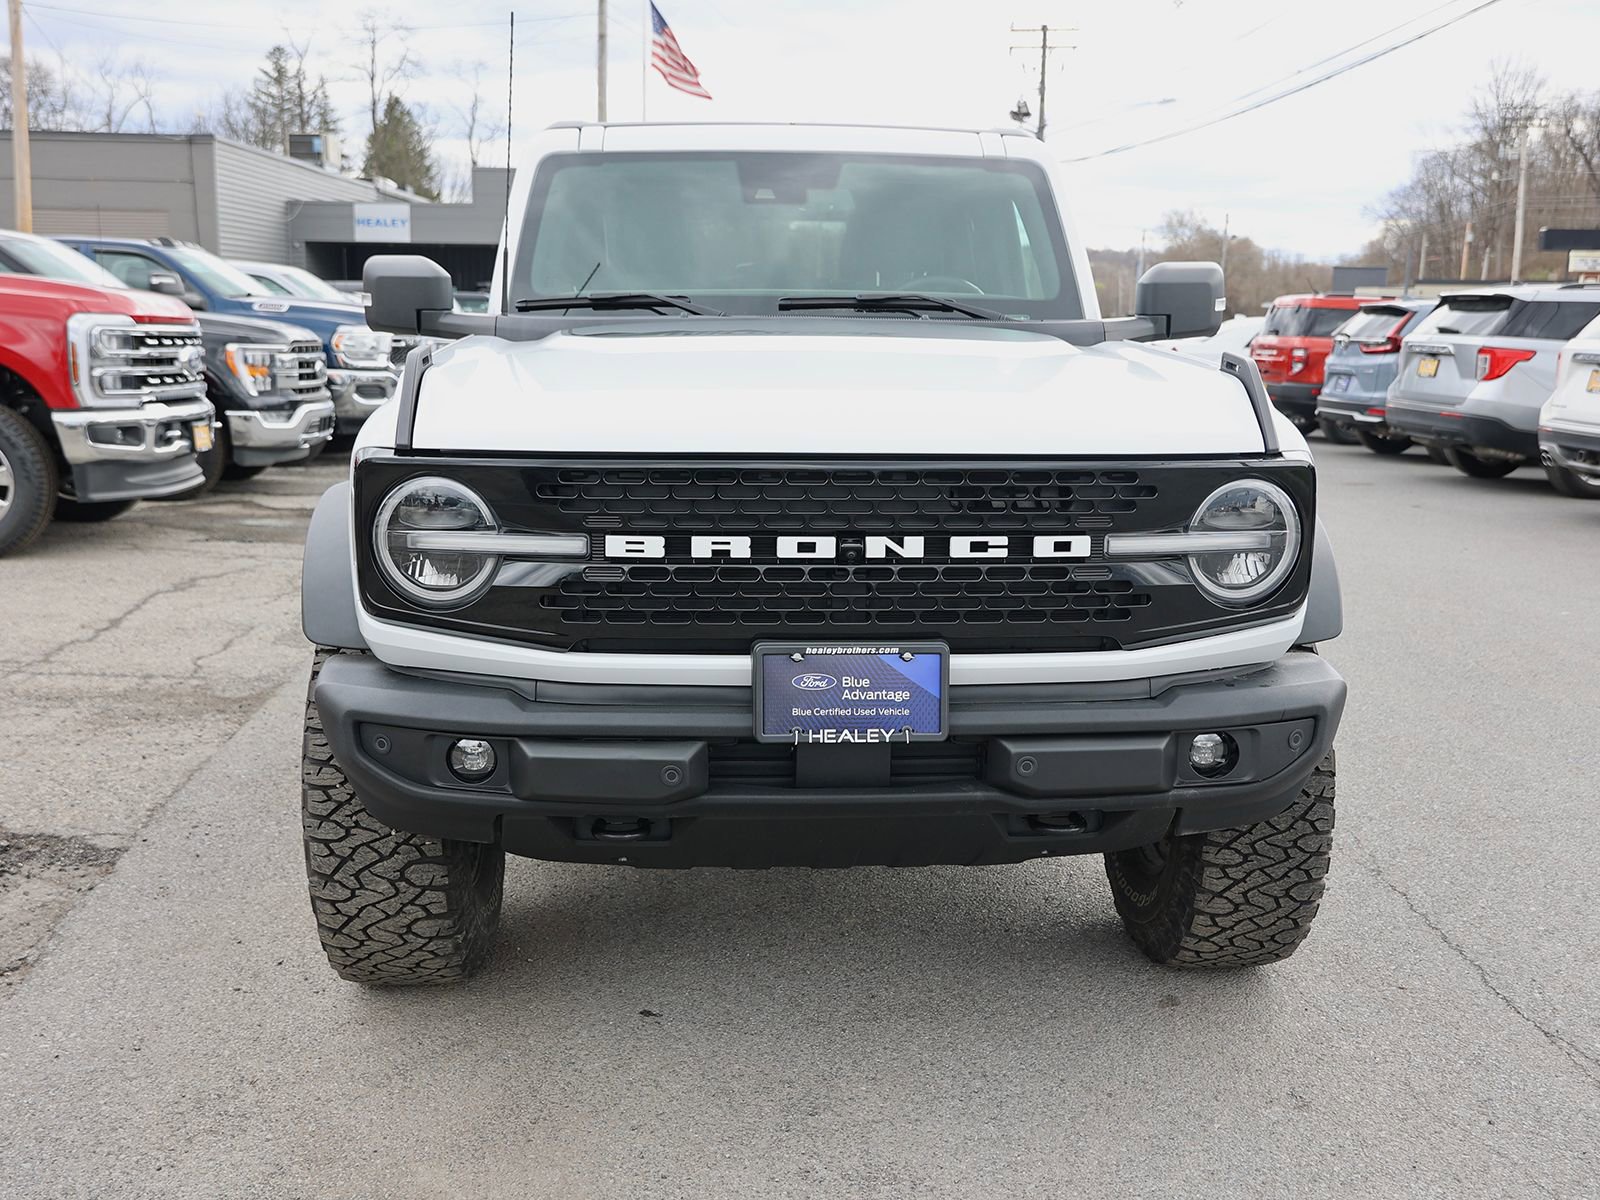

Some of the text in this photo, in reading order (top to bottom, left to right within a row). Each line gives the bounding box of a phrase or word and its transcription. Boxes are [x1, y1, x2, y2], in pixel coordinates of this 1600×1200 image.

[356, 217, 408, 228] HEALEY
[604, 535, 1092, 559] BRONCO
[805, 646, 899, 656] healeybrothers.com
[842, 676, 870, 688] Blue
[841, 689, 911, 702] Advantage
[791, 707, 910, 716] Blue Certified Used Vehicle
[808, 728, 896, 744] HEALEY
